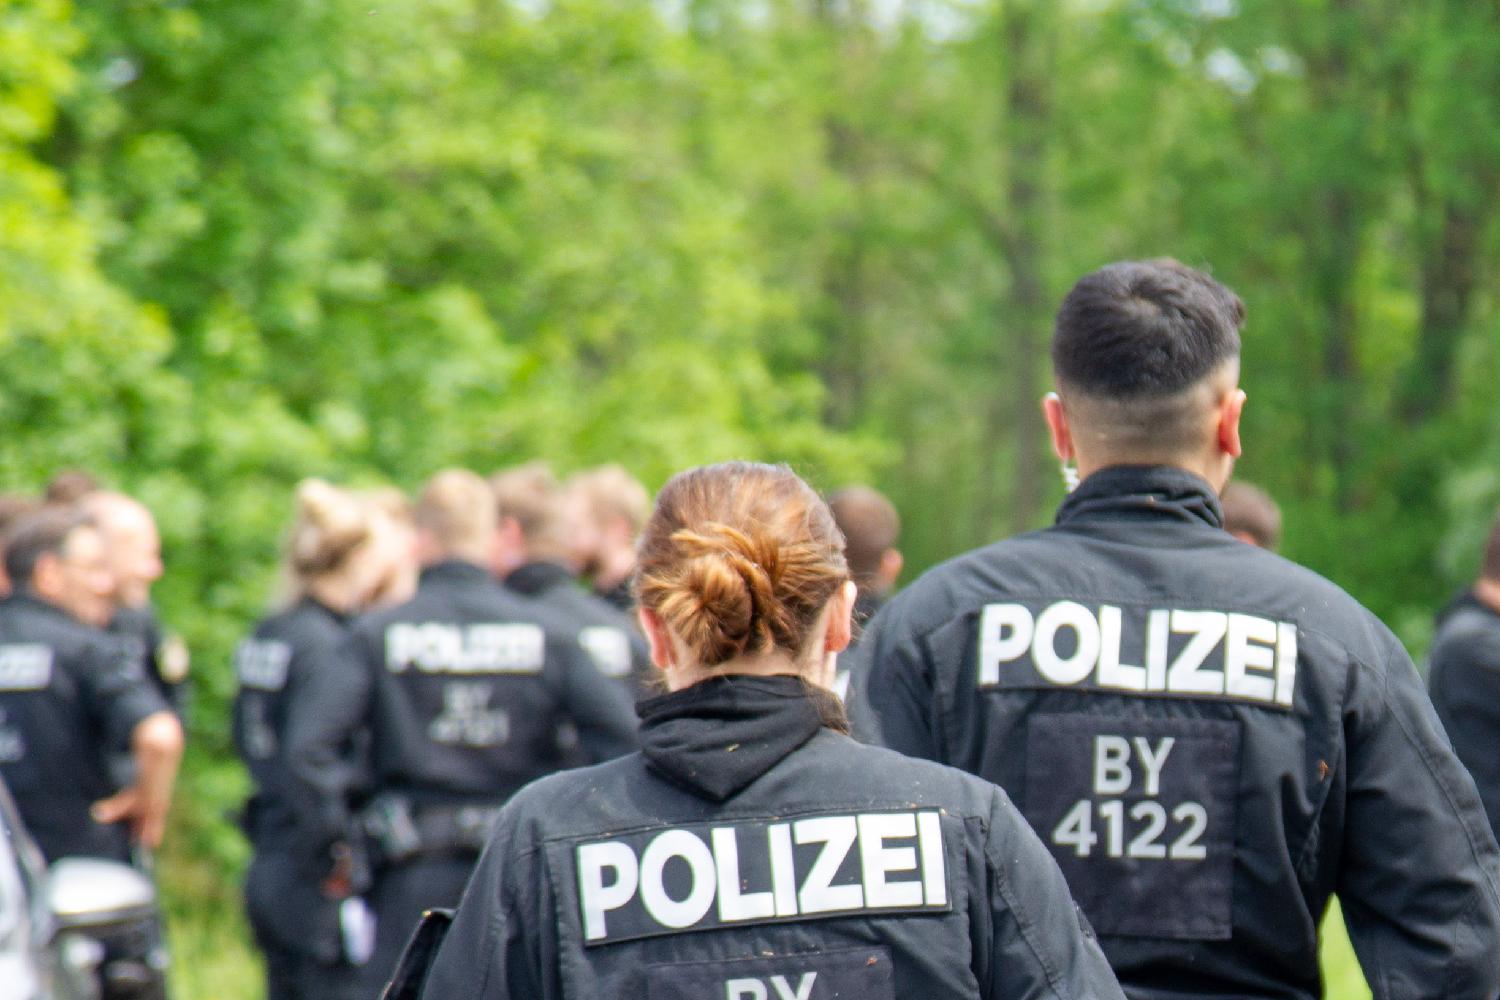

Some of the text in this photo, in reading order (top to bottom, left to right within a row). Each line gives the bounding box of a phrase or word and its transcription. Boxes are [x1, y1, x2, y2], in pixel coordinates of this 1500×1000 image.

[978, 600, 1299, 706] POLIZEI
[1093, 735, 1175, 796] BY
[1051, 799, 1208, 860] 4122
[577, 811, 948, 940] POLIZEI
